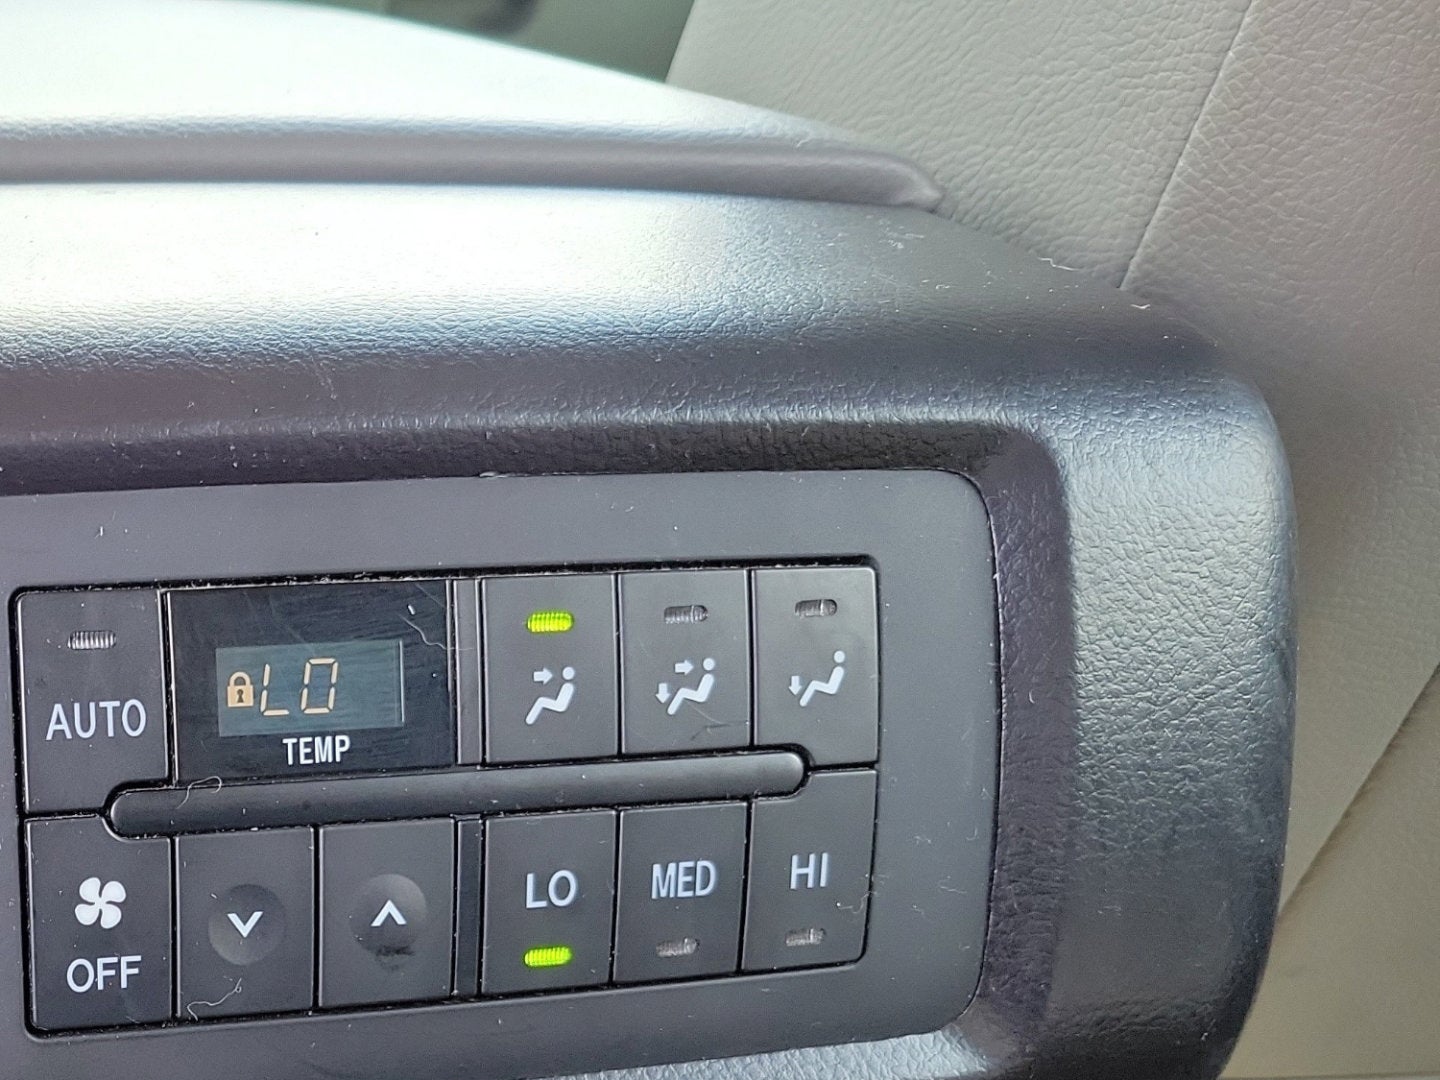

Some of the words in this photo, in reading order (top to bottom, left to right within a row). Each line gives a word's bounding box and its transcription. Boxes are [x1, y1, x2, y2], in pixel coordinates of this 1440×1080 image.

[46, 699, 147, 741] AUTO
[282, 735, 351, 766] TEMP
[526, 870, 577, 909] LO
[651, 860, 717, 900] MED
[789, 852, 830, 890] HI
[66, 955, 142, 993] OFF
